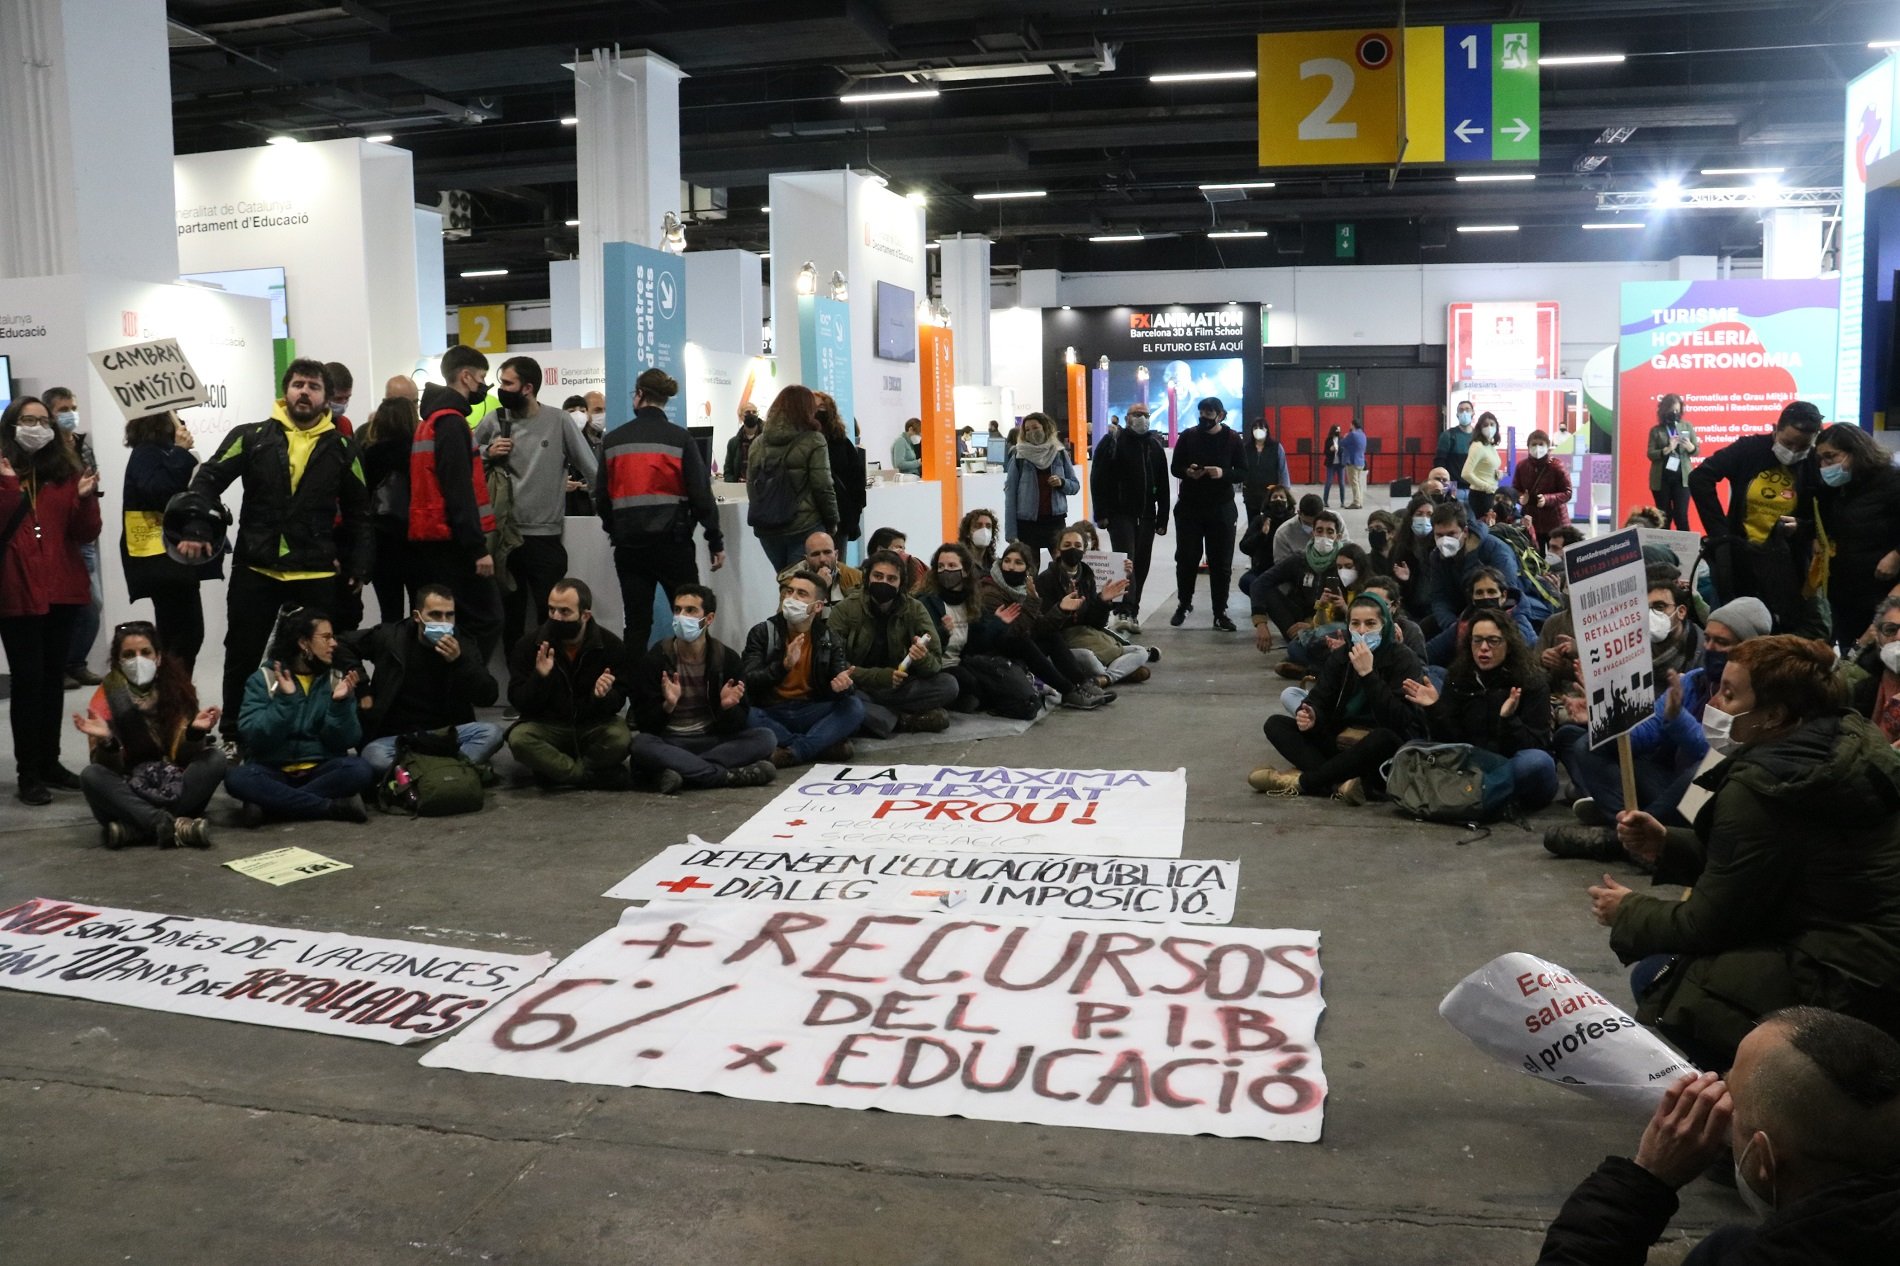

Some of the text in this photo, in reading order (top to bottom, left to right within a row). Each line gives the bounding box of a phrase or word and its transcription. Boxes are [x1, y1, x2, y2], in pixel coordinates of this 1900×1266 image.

[1459, 35, 1477, 69] 1
[1298, 58, 1357, 140] 2
[241, 212, 309, 230] d'Educació
[635, 265, 644, 362] centres
[645, 268, 654, 368] d'adults
[1130, 311, 1243, 328] FX ANIMATION
[1652, 307, 1739, 324] TURISME
[474, 316, 492, 348] 2
[1130, 326, 1243, 338] Barcelona 3D & Film School
[1652, 330, 1760, 347] HOTELERIA
[103, 343, 187, 371] CAMBRAY
[1143, 340, 1243, 352] EL FUTURO ESTÁ AQUÍ
[1651, 351, 1802, 369] GASTRONOMIA
[1324, 391, 1339, 399] EXIT
[1464, 381, 1497, 389] salesians
[1685, 393, 1728, 402] Formatius
[1731, 393, 1742, 402] de
[1743, 393, 1764, 402] Grau
[1766, 392, 1789, 403] Mitjà
[1731, 402, 1782, 412] Restauració
[1729, 423, 1741, 432] de
[1741, 424, 1764, 432] Grau
[1760, 470, 1791, 487] SOS
[1583, 597, 1639, 626] SÓN 10 ANYS DE
[1585, 611, 1642, 643] RETALLADES
[1594, 668, 1602, 677] DE
[833, 767, 898, 781] LA
[798, 783, 1111, 801] COMPLEXITAT
[871, 800, 1099, 825] PROU!
[681, 849, 876, 875] DEFENSEM
[1066, 859, 1227, 890] PÚBLICA
[0, 900, 102, 936] NO
[63, 918, 137, 940] SÓN
[118, 916, 194, 942] 5
[221, 935, 297, 960] DE
[296, 943, 520, 993] VACANCES,
[722, 911, 1318, 1001] RECURSOS
[36, 943, 150, 981] 10
[91, 956, 209, 986] ANYS
[177, 979, 232, 996] DE
[1516, 970, 1581, 997] Equ
[217, 967, 489, 1034] RETALLADES
[802, 990, 1000, 1035] DEL
[815, 1033, 1322, 1114] EDUCACIÓ
[1523, 1054, 1541, 1075] el
